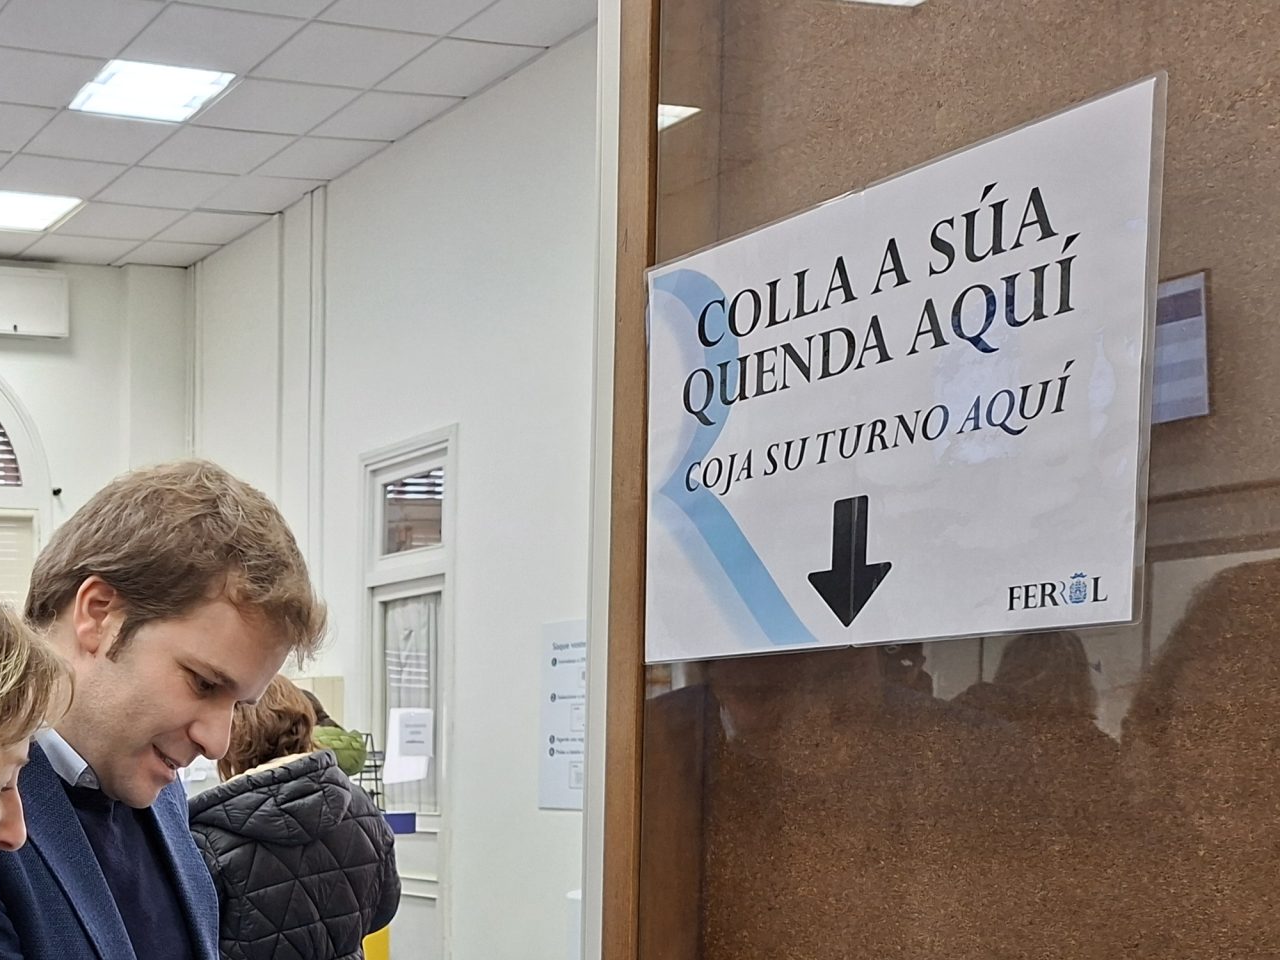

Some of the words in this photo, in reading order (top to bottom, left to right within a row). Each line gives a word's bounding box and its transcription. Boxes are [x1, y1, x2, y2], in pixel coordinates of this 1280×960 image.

[683, 314, 894, 426] QUENDA
[906, 232, 1081, 353] AQUÍ
[697, 255, 858, 347] COLLA
[870, 237, 911, 295] A
[929, 182, 1059, 277] SÚA
[685, 449, 754, 496] COJA
[763, 435, 808, 477] SU
[815, 403, 950, 465] TURNO
[956, 360, 1076, 436] AQUÍ
